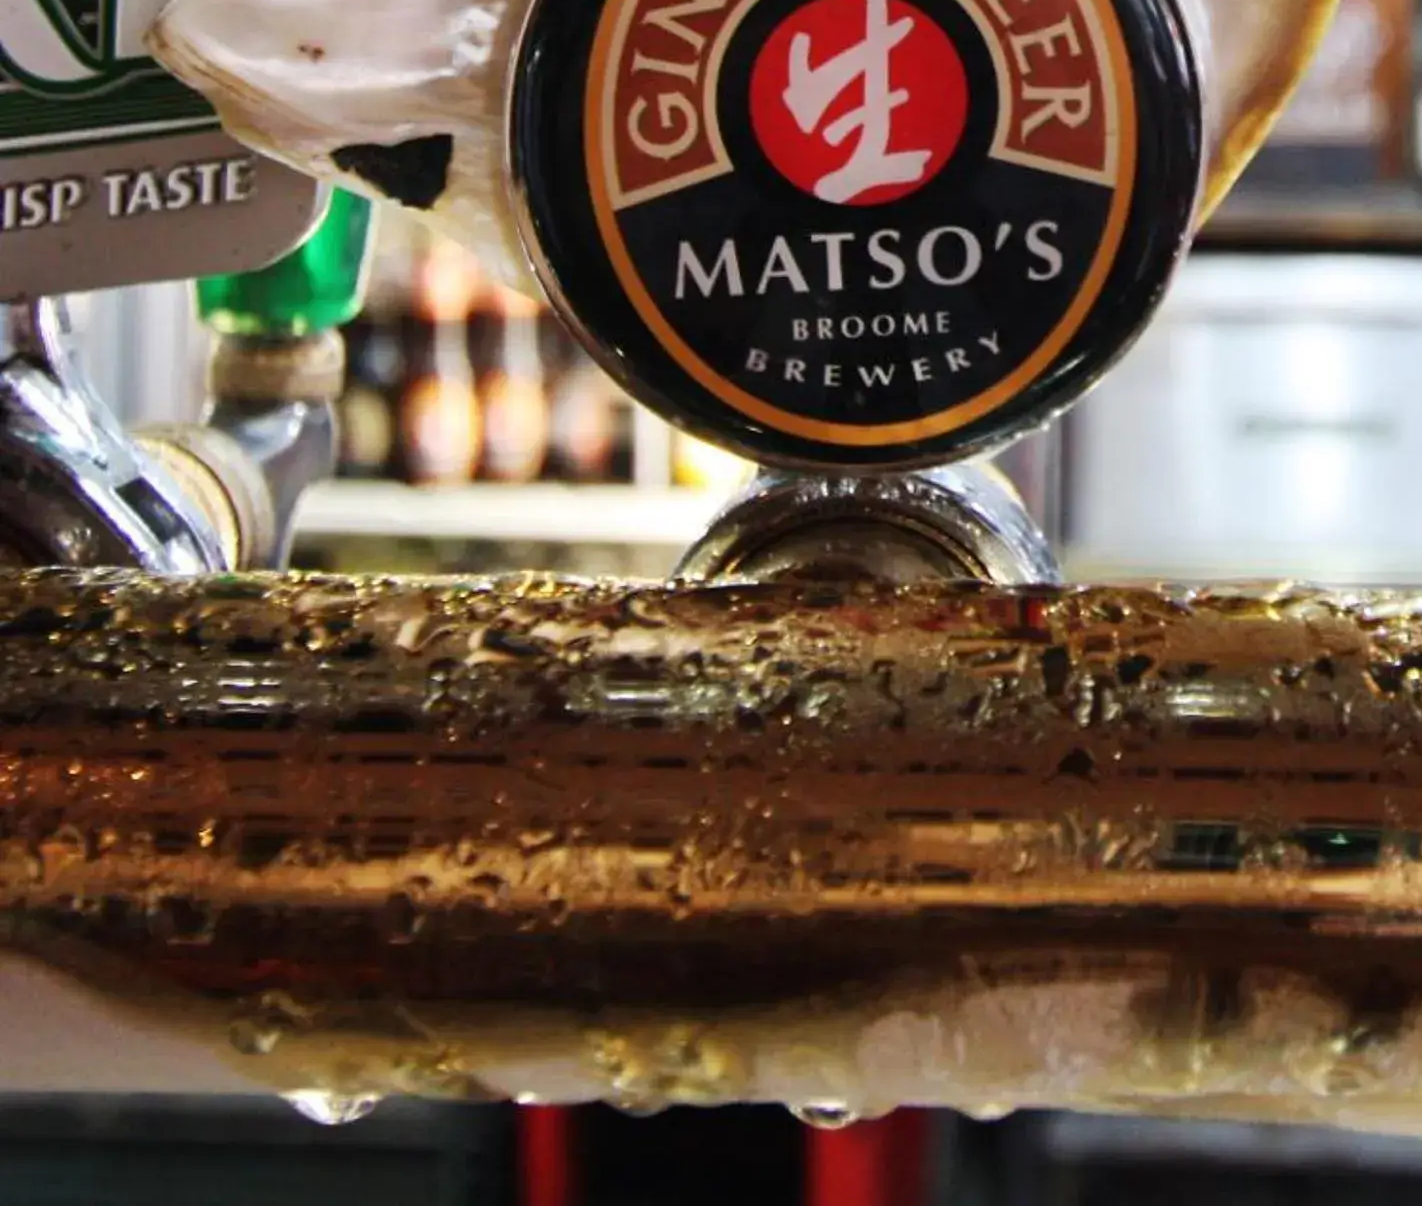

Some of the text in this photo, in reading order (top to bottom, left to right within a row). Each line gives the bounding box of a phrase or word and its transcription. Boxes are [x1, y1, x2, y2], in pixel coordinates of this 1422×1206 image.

[103, 159, 249, 217] TASTE
[673, 219, 1064, 300] MATSO'S
[792, 310, 952, 341] BROOME
[745, 329, 1003, 389] BREWERY
